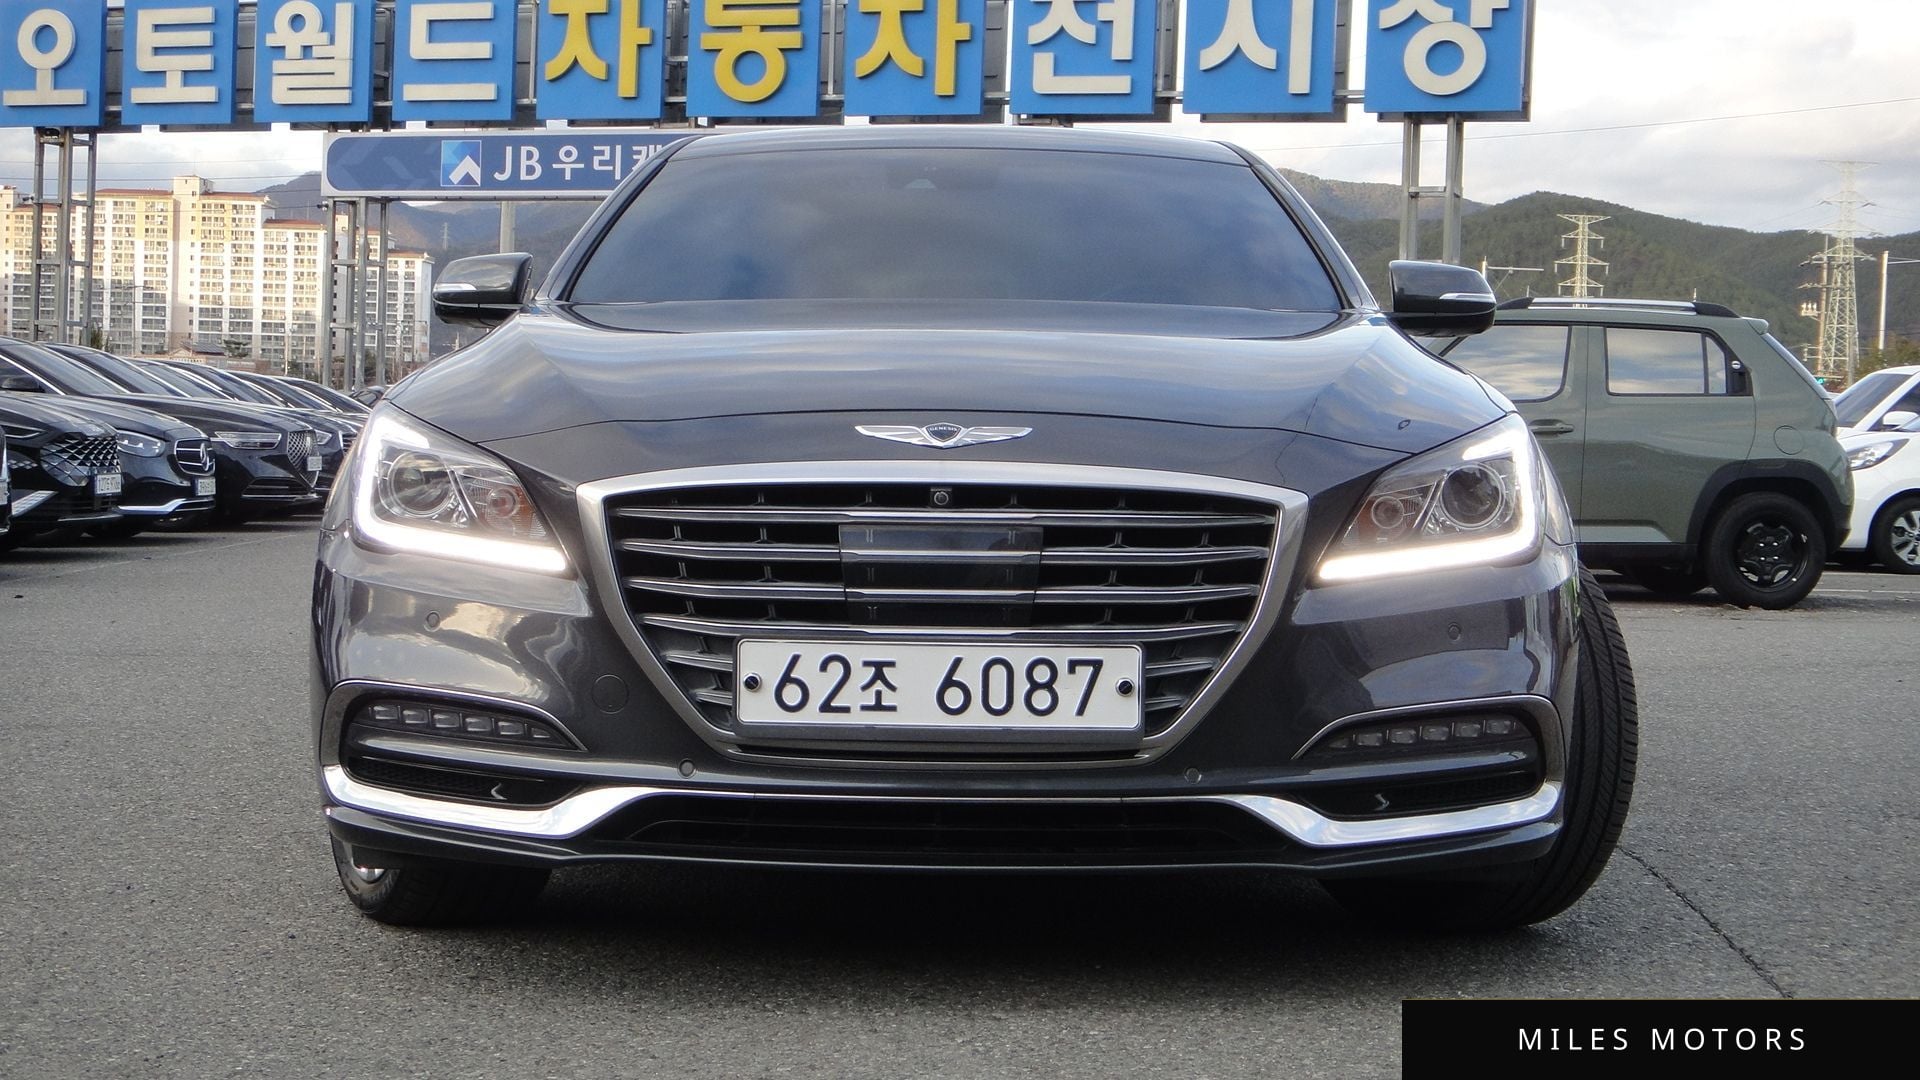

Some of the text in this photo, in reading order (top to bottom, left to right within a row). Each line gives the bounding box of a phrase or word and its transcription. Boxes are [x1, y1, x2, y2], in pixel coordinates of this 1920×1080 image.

[2, 1, 498, 105] 오토월드
[774, 654, 1103, 716] 62조 6087
